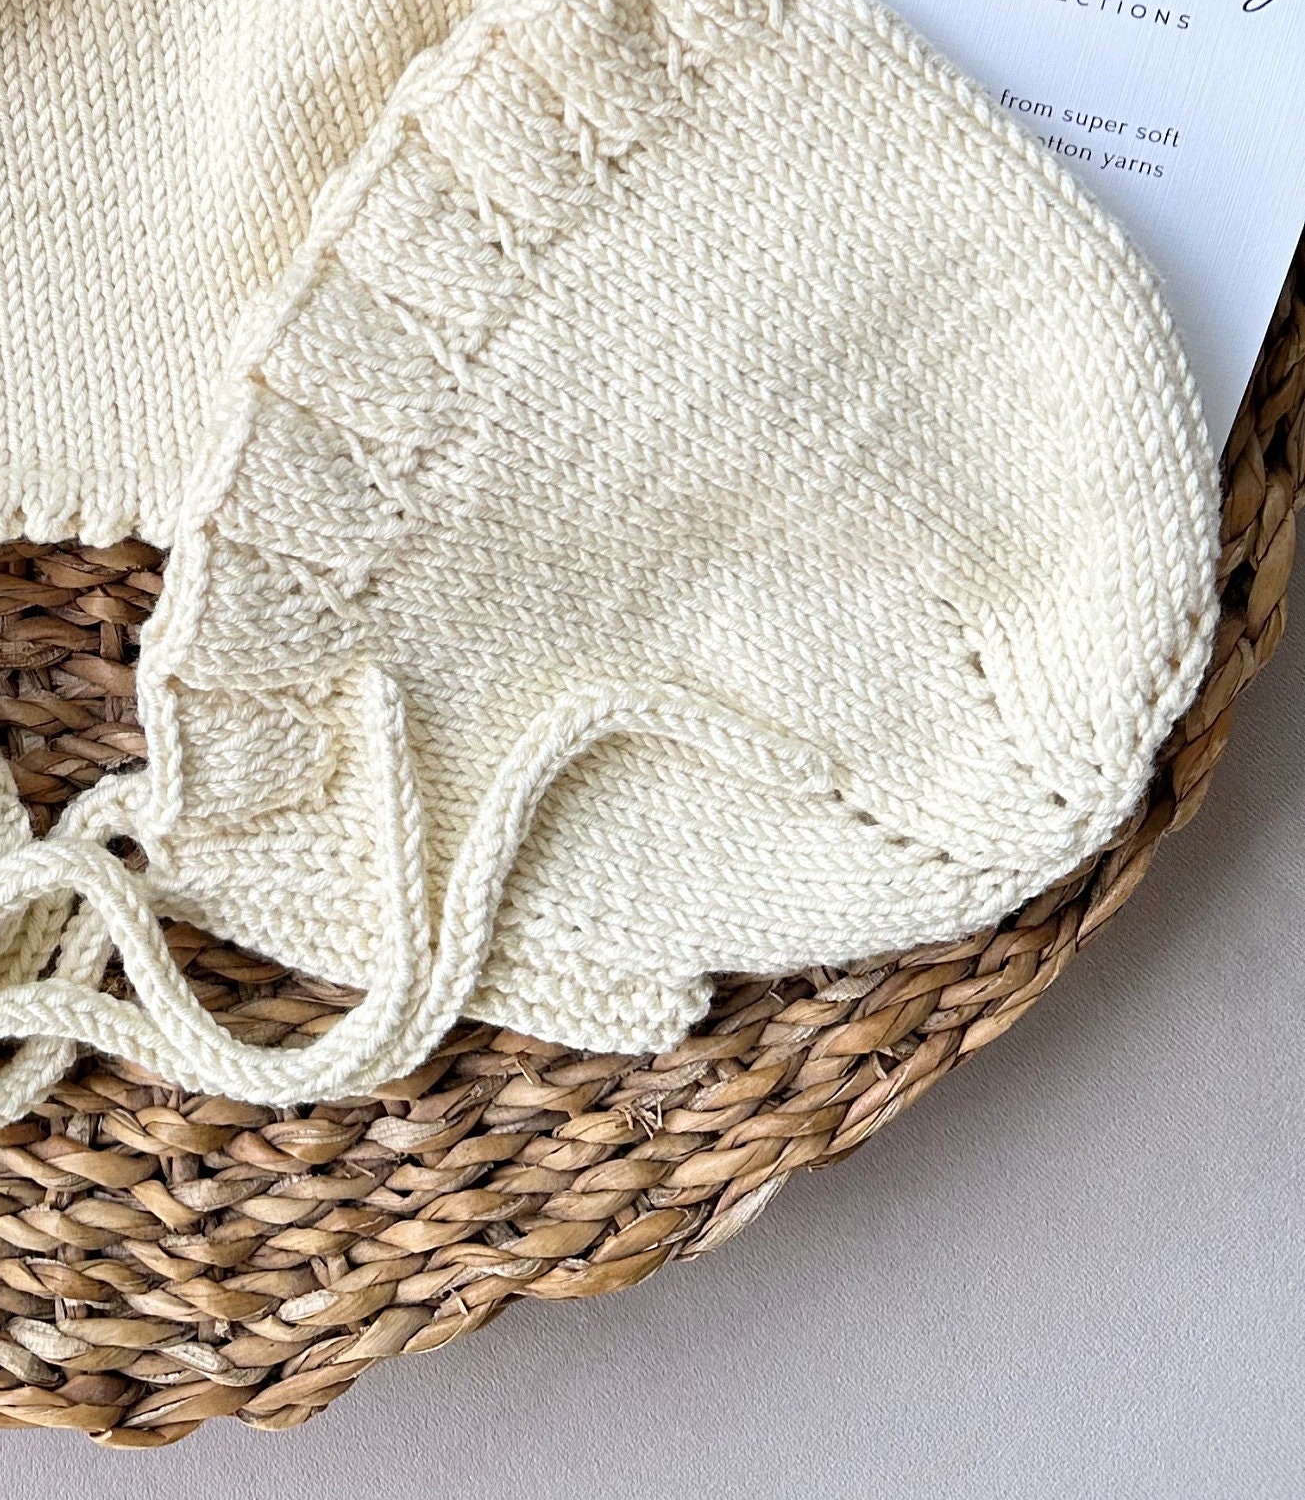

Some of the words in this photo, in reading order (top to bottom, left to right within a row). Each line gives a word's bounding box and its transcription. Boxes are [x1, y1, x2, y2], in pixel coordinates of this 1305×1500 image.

[999, 88, 1053, 118] from
[1062, 107, 1128, 134] super
[1135, 126, 1181, 148] soft
[1100, 151, 1165, 178] yarns
